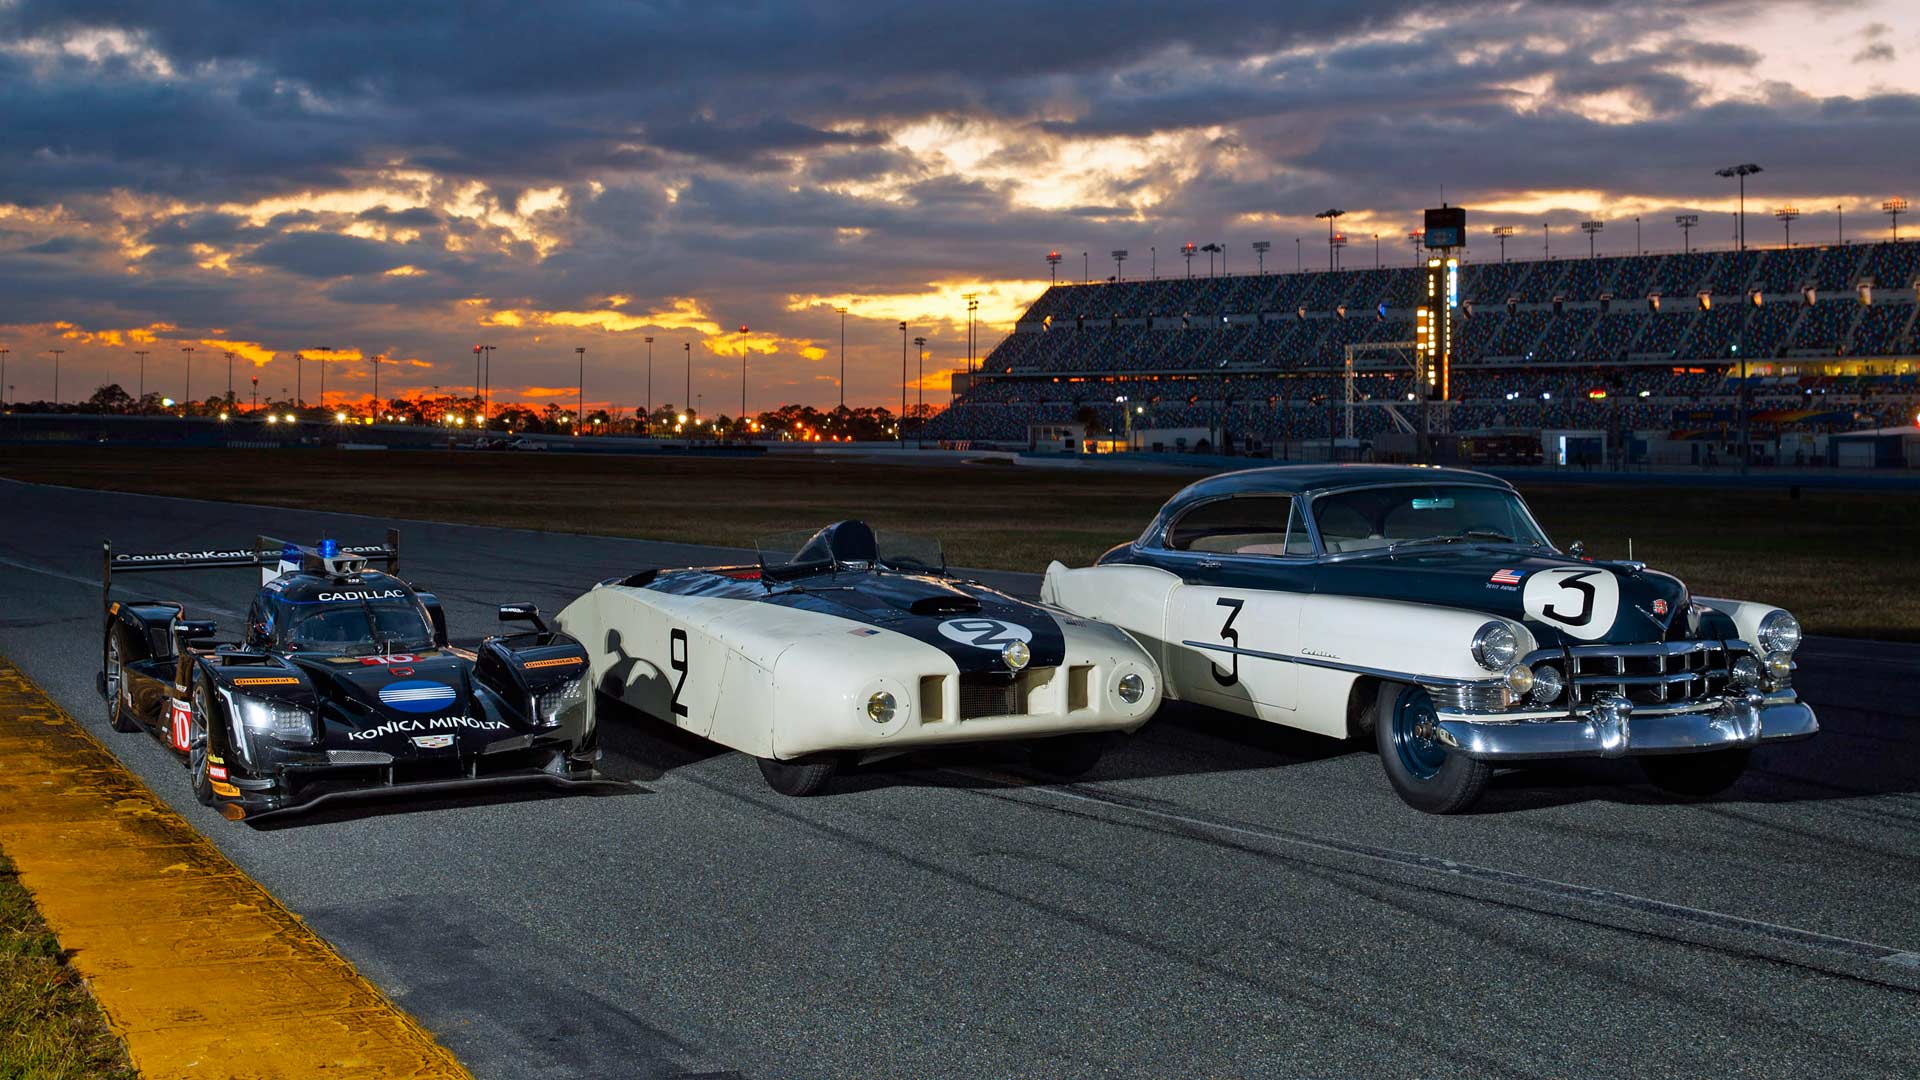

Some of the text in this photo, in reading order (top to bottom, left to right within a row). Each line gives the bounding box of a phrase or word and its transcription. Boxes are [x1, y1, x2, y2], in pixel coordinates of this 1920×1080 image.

[318, 589, 405, 601] CADILLAC
[1542, 569, 1603, 627] 3
[948, 620, 1021, 646] 2
[1211, 597, 1245, 687] 3
[367, 655, 414, 664] 10
[1301, 647, 1341, 659] Cadillac
[174, 709, 190, 749] 10
[348, 716, 511, 741] KONICA MINOLTA
